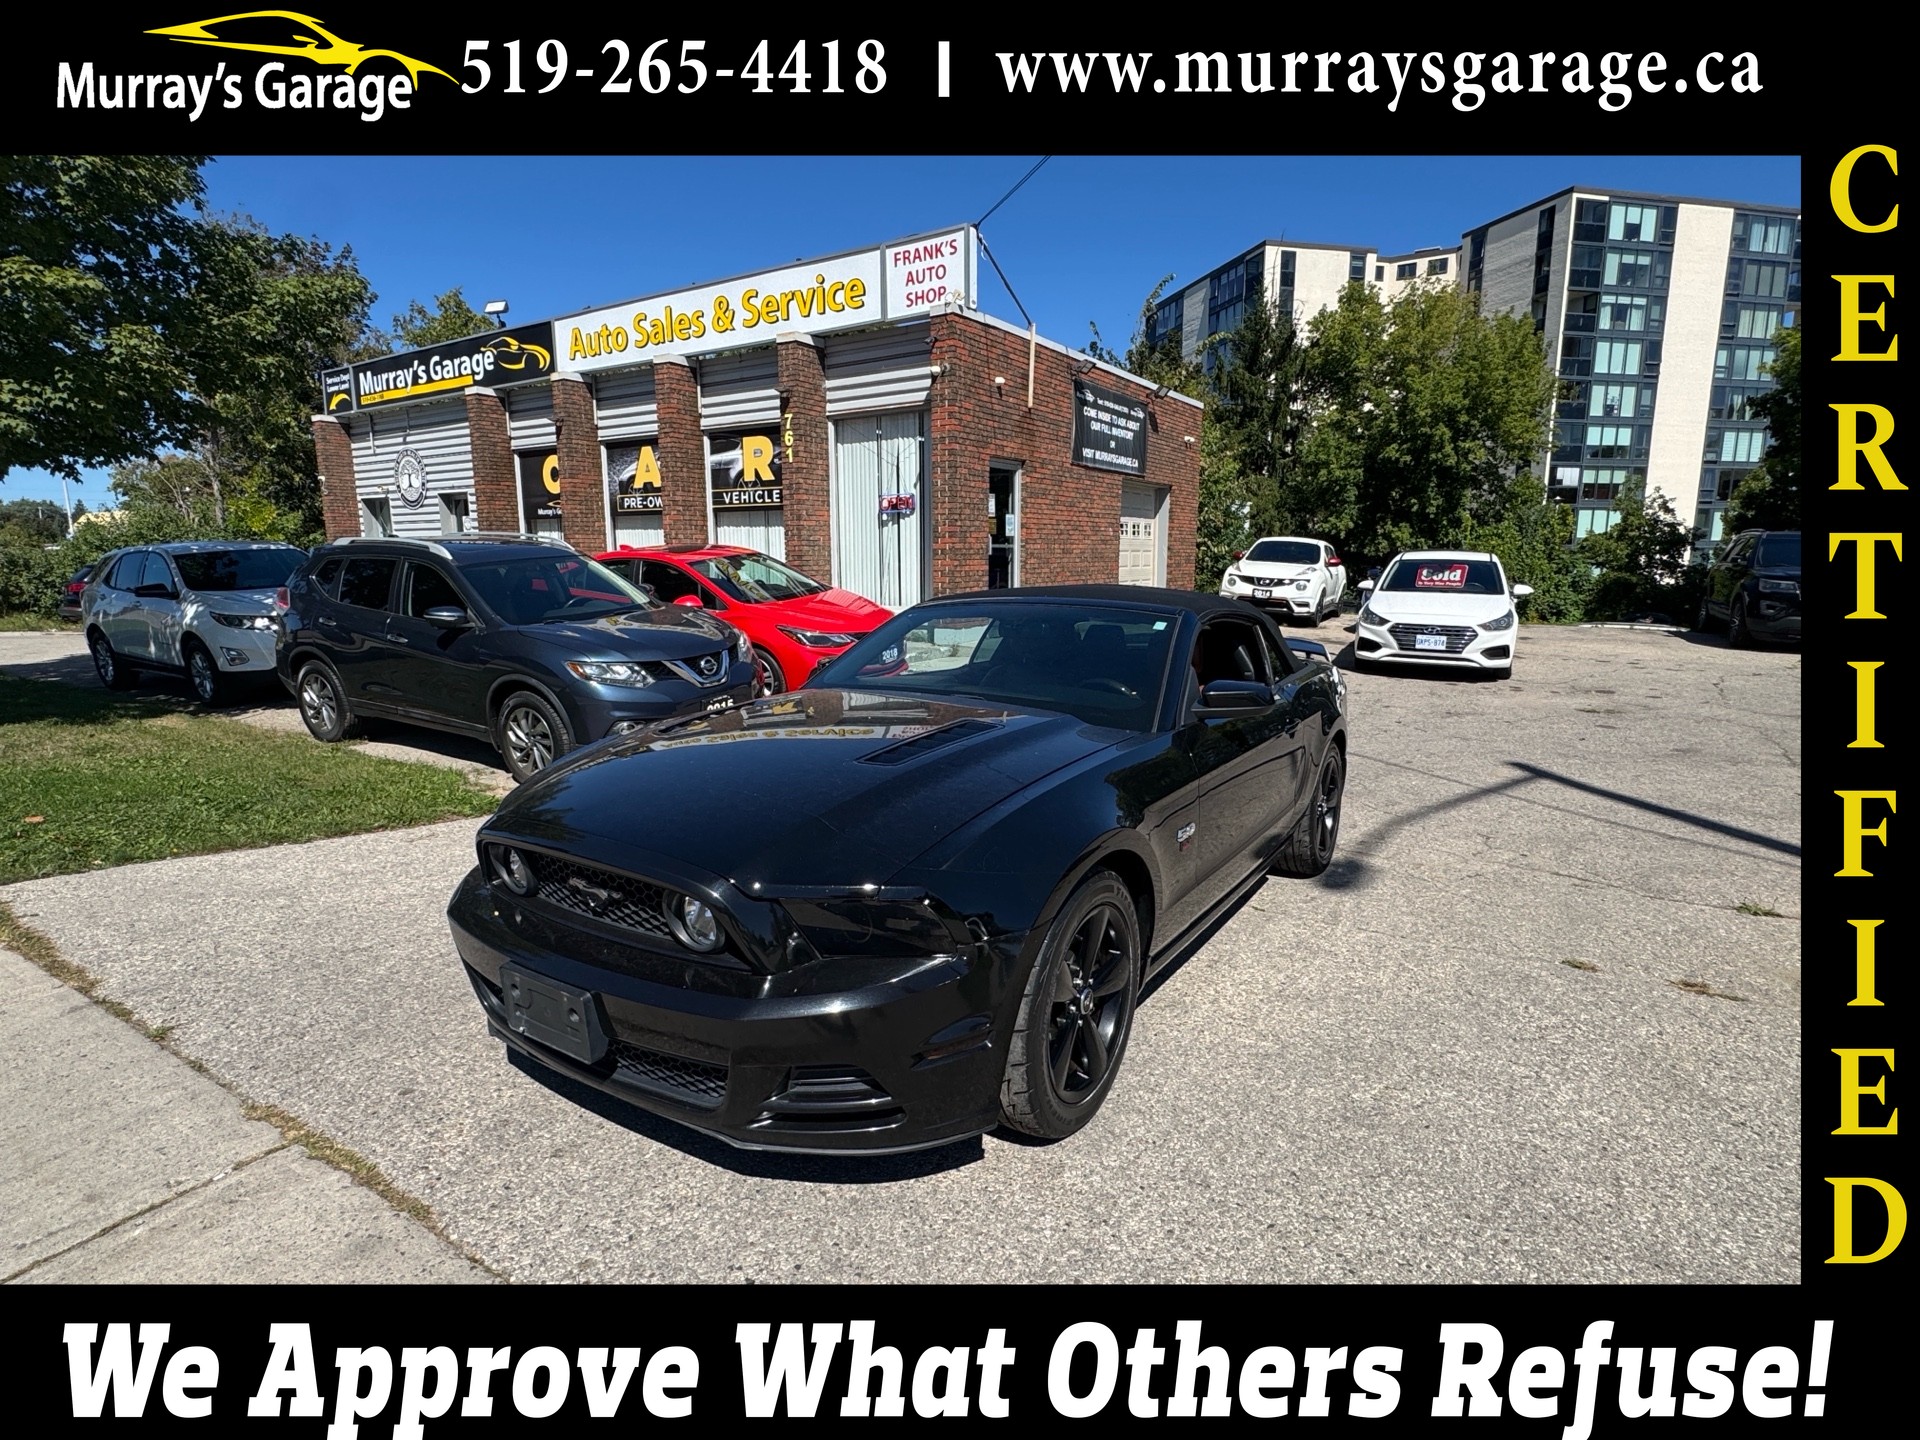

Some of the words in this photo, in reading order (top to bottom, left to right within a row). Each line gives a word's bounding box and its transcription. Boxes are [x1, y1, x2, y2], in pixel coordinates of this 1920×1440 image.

[893, 239, 958, 268] FRANK'S
[905, 264, 946, 287] AUTO
[905, 285, 946, 308] SHOP
[569, 327, 628, 360] Auto
[633, 306, 705, 346] Sales
[712, 296, 735, 332] &
[742, 274, 866, 328] Service
[359, 360, 427, 395] Murray's
[430, 350, 495, 380] Garage
[1083, 406, 1098, 419] COME
[1112, 415, 1118, 425] TO
[1118, 418, 1127, 428] ASK
[1127, 420, 1140, 431] ABOUT
[1090, 420, 1101, 431] OUR
[1101, 424, 1112, 434] FULL
[633, 446, 661, 489] A
[743, 435, 775, 482] R
[723, 490, 781, 504] VEHICLE
[880, 496, 913, 510] OPEN
[1421, 569, 1462, 581] Sold
